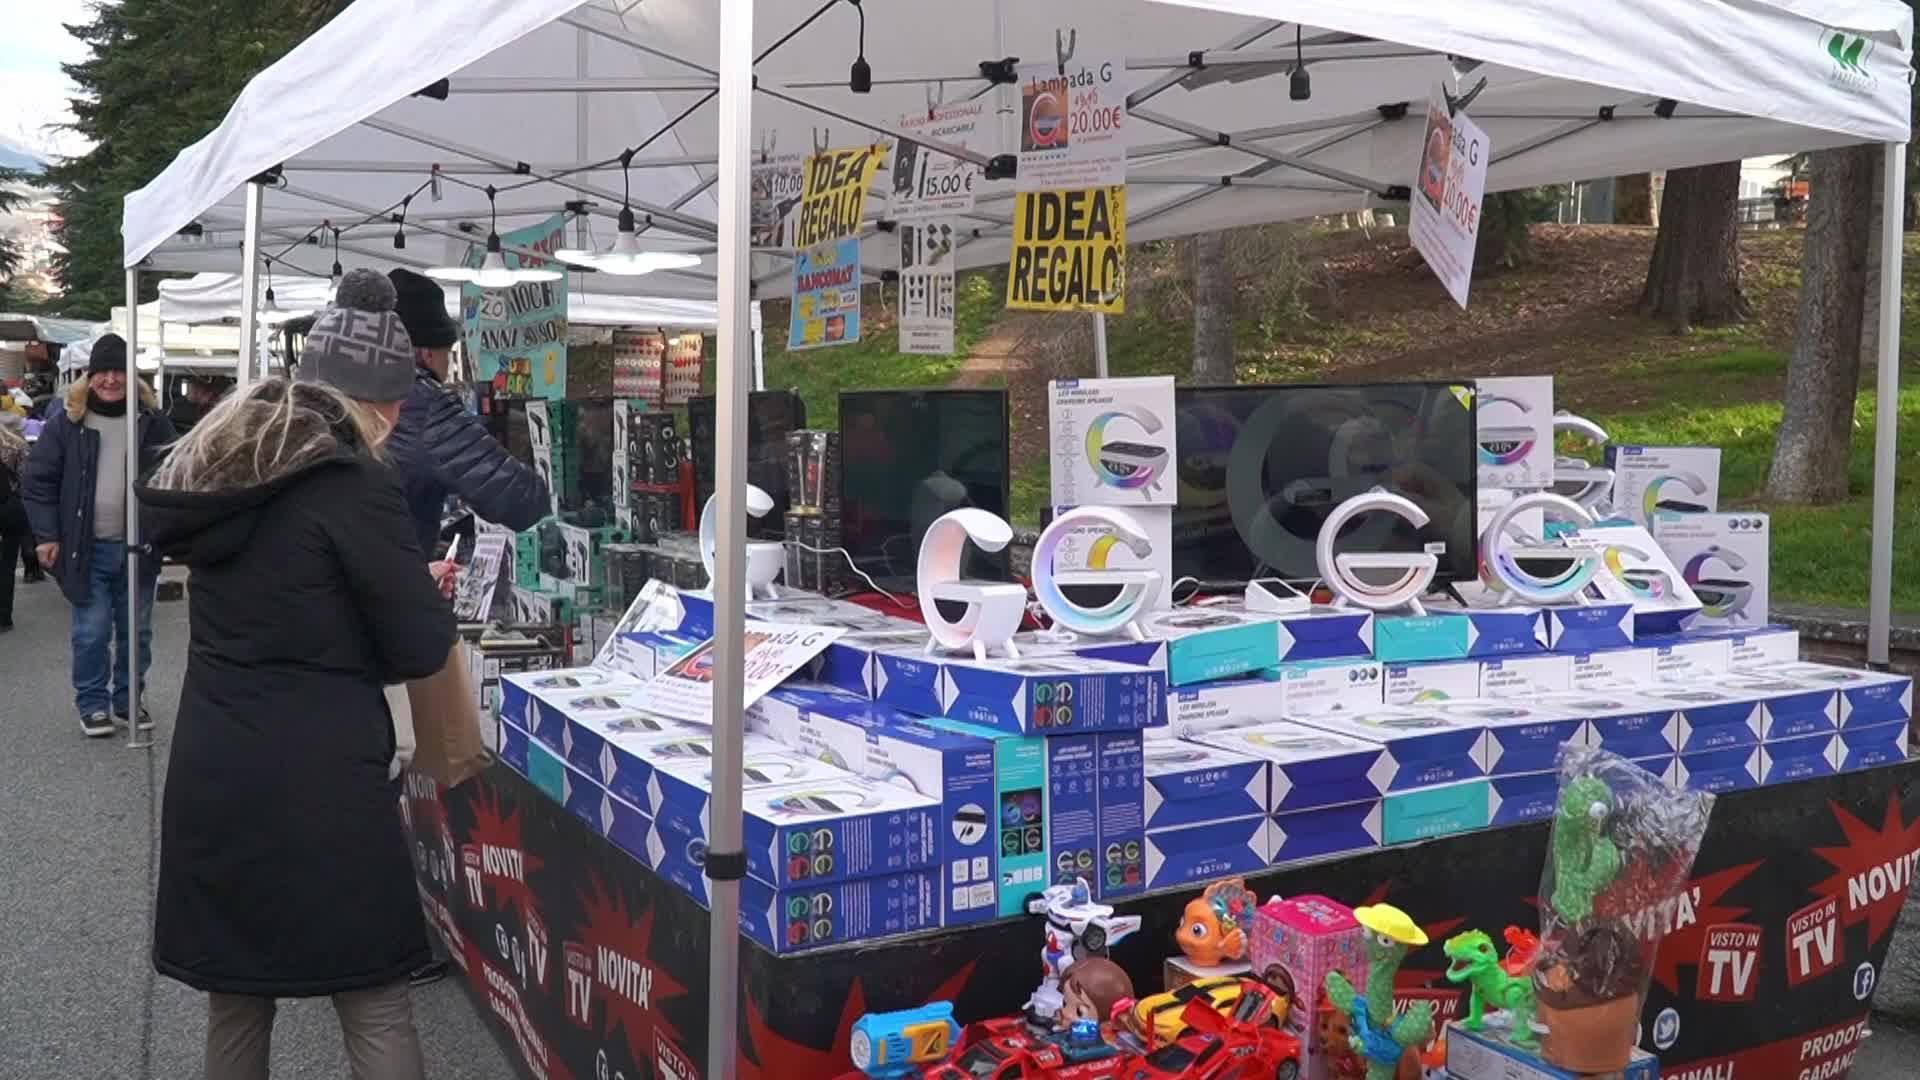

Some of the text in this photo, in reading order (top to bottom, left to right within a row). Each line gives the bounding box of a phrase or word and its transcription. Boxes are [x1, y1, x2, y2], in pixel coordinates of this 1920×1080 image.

[1100, 62, 1112, 82] G
[1070, 105, 1120, 134] 20.00€
[807, 149, 871, 197] IDEA
[1469, 138, 1480, 166] G
[926, 174, 961, 197] 15.00
[798, 186, 862, 248] REGALO
[1023, 189, 1112, 241] IDEA
[1012, 245, 1119, 306] REGALO
[1711, 932, 1760, 947] VISTO IN
[1791, 900, 1836, 935] VISTO IN
[527, 923, 547, 985] TV
[1792, 917, 1836, 977] TV
[597, 945, 652, 1011] NOVITA'
[1708, 950, 1757, 995] TV
[567, 967, 592, 1024] TV
[1442, 998, 1459, 1015] IN
[656, 1037, 687, 1078] VISTO
